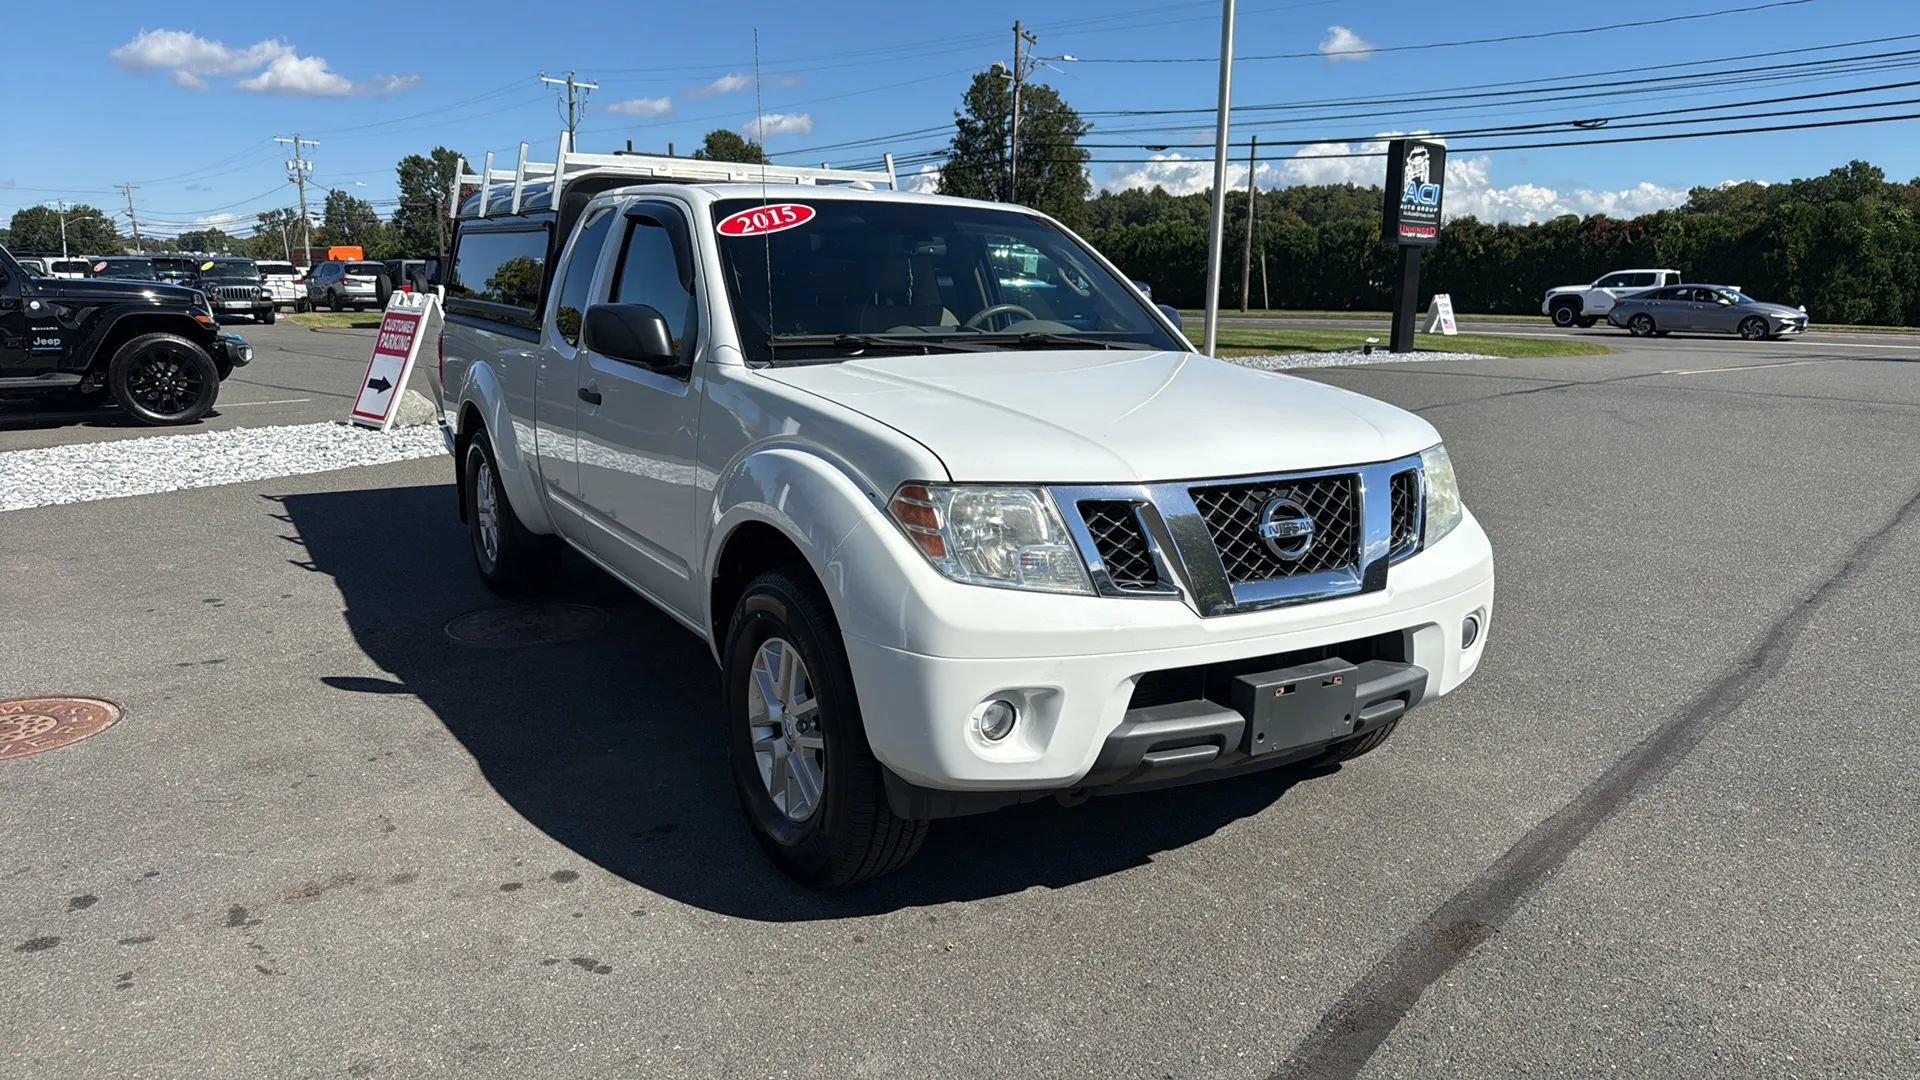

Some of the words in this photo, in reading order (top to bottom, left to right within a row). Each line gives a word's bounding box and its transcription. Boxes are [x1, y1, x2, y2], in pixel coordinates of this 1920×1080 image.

[1402, 181, 1440, 205] ACI
[1417, 205, 1438, 213] GROUP
[737, 206, 797, 233] 2015
[384, 318, 416, 333] CUSTOMER
[33, 337, 61, 346] Jeep
[378, 332, 412, 351] PARKING
[1268, 521, 1313, 535] NISSAN
